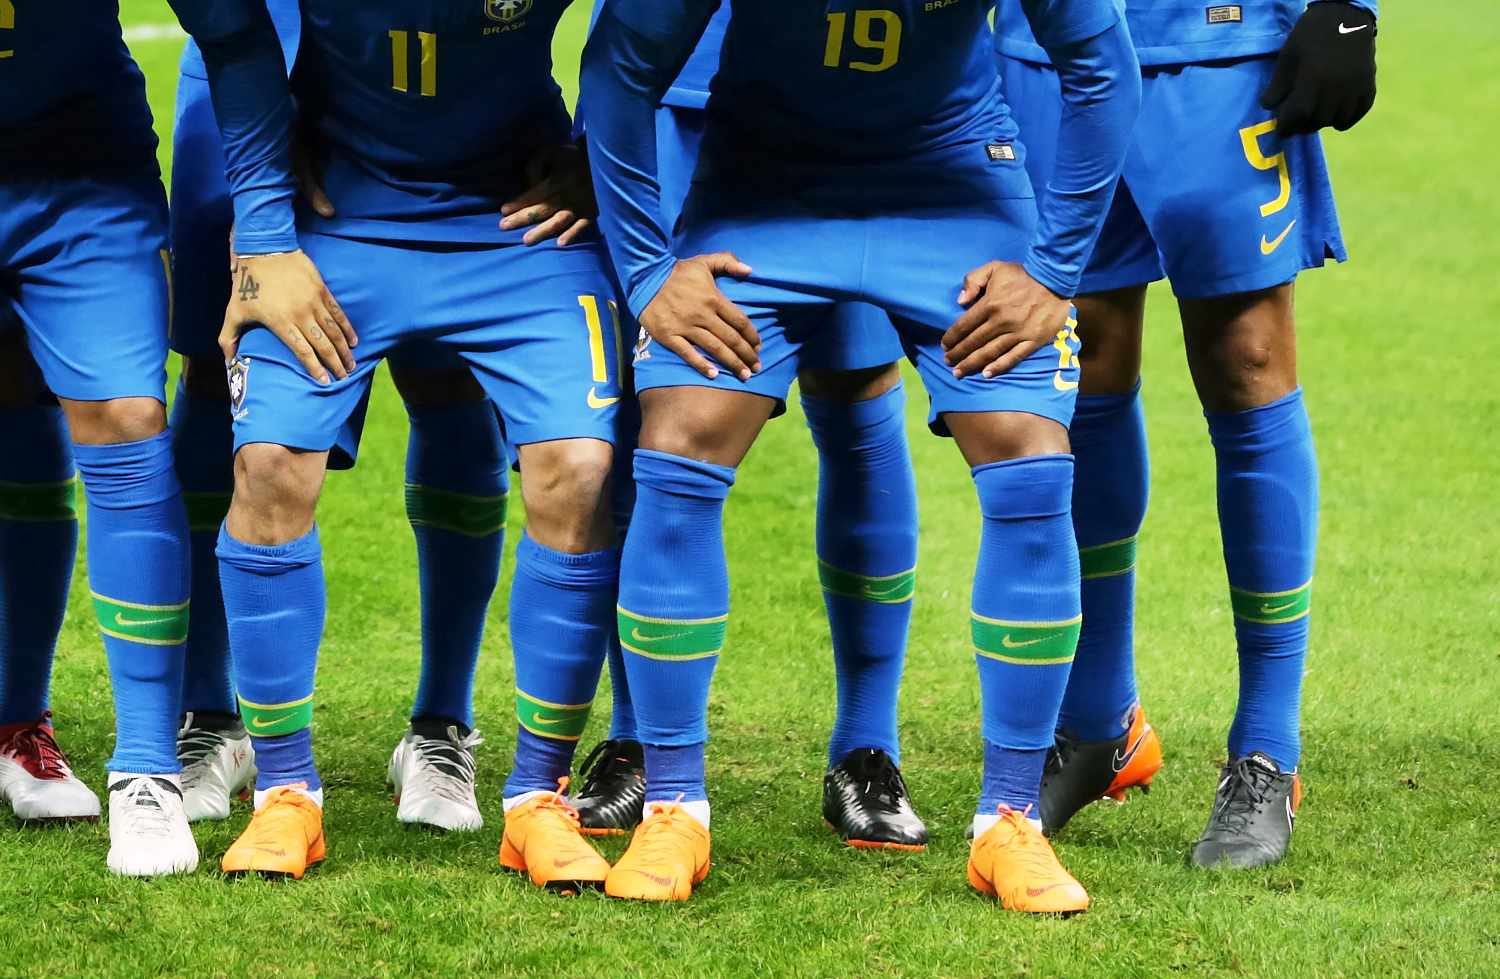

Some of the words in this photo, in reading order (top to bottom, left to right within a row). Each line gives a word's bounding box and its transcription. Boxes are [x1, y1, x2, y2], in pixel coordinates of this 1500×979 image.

[388, 29, 437, 97] 11
[823, 9, 902, 72] 19
[1238, 117, 1291, 218] 5
[238, 266, 260, 301] LA
